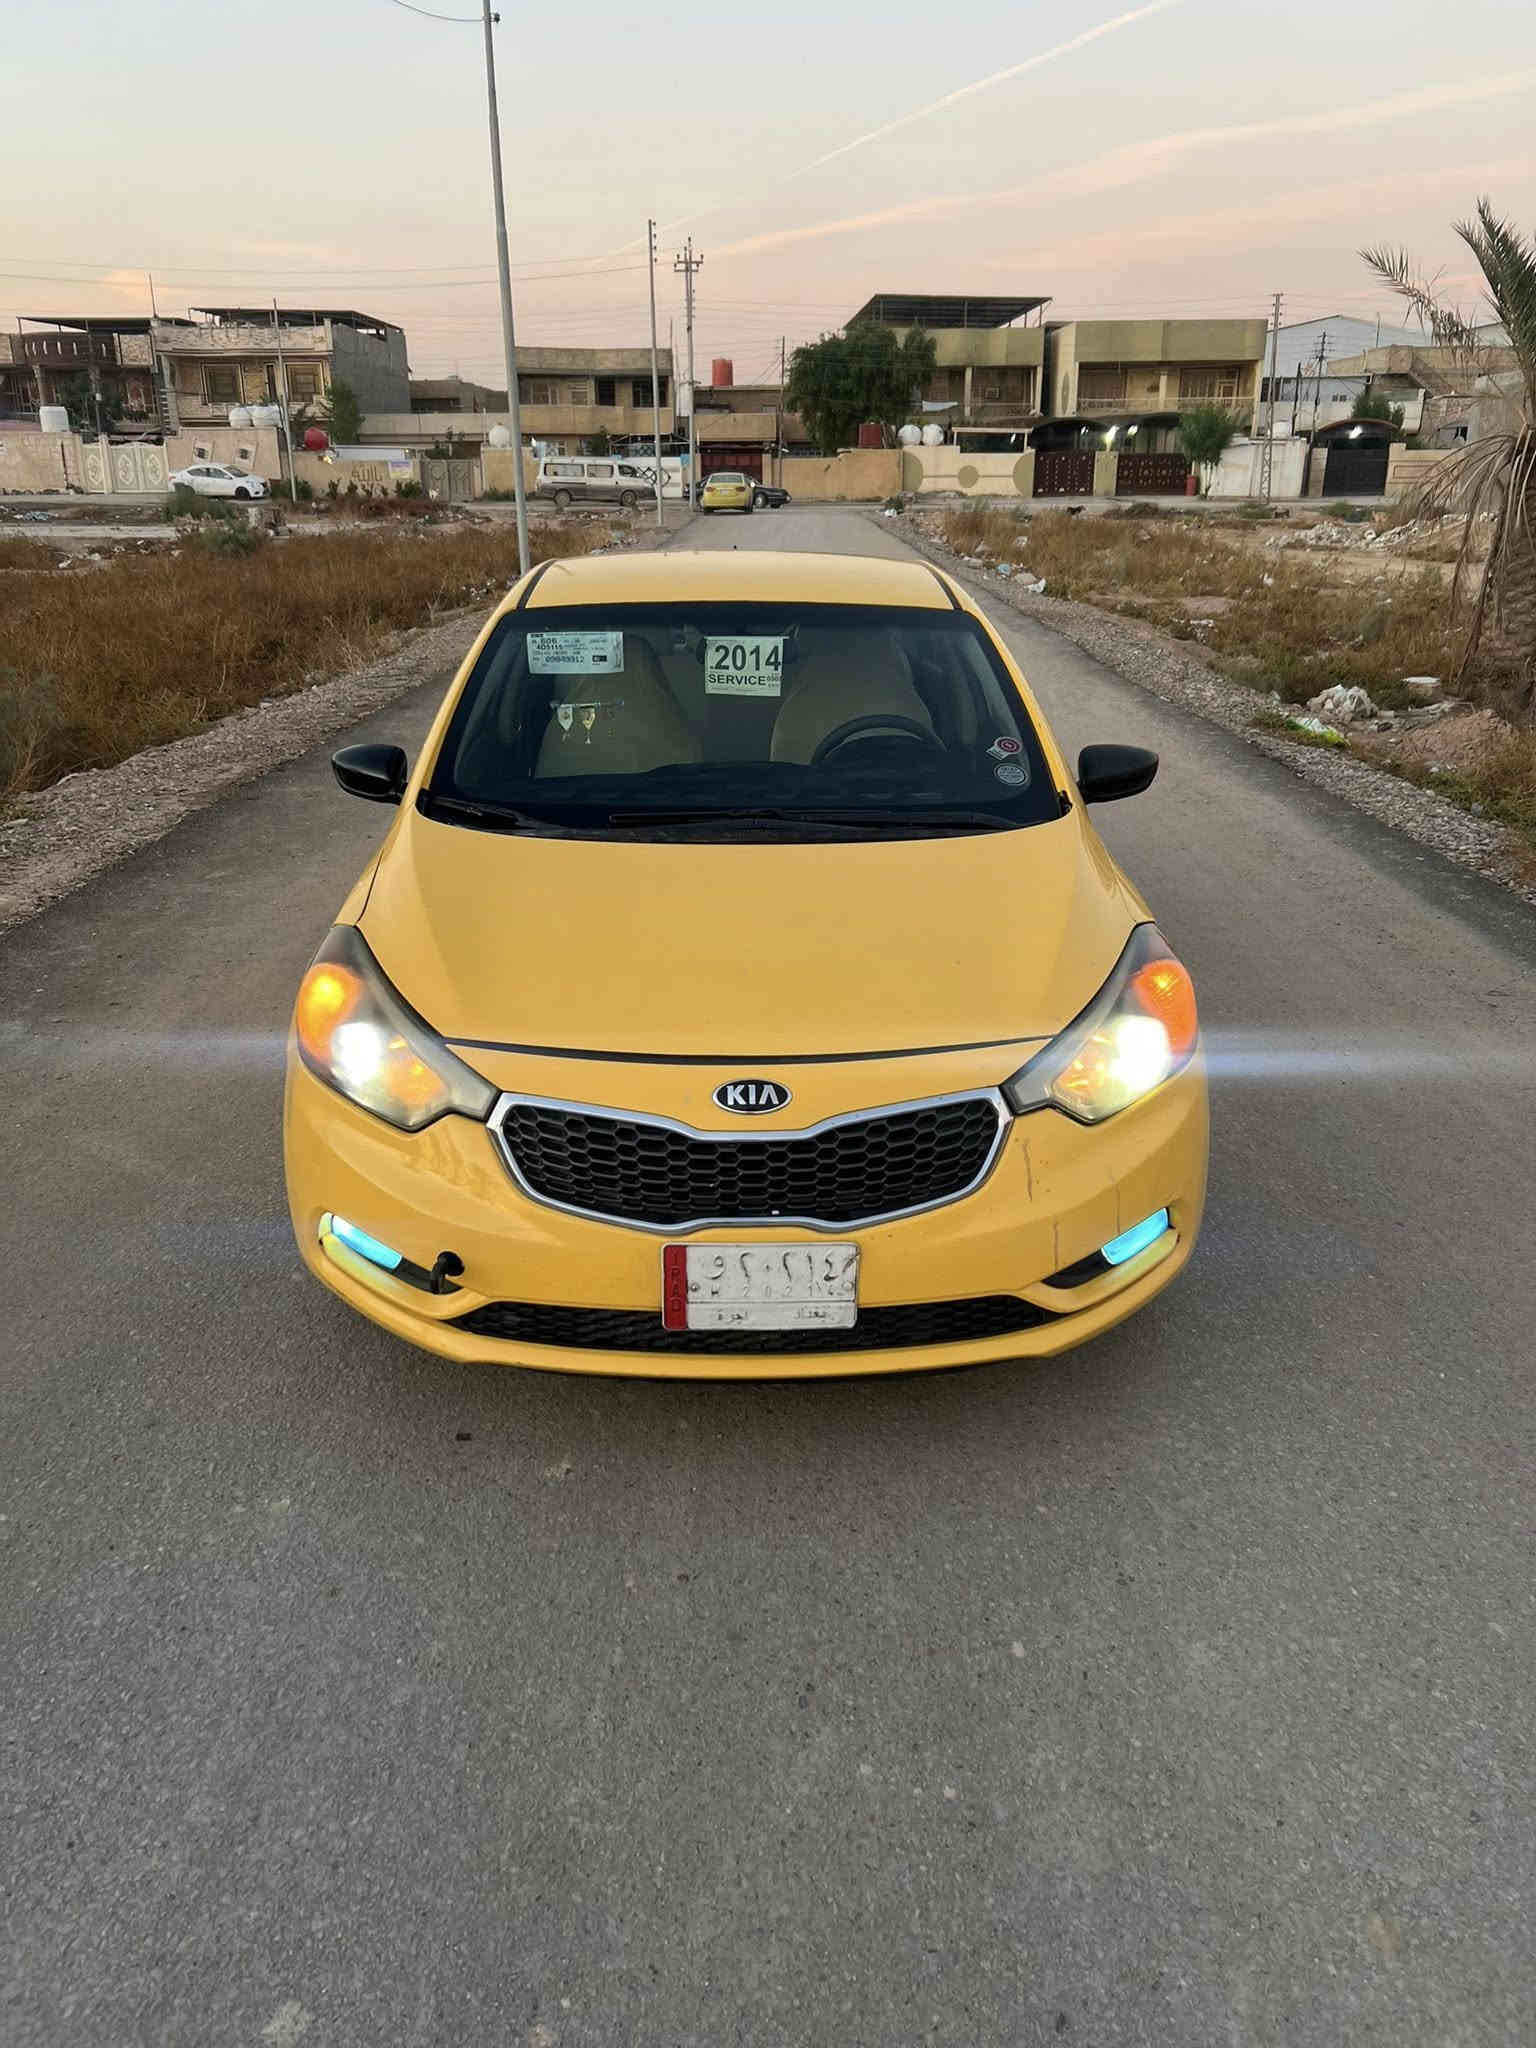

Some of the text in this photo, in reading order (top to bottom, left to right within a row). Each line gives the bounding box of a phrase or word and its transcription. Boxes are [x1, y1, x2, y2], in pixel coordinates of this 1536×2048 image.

[714, 645, 781, 672] 2014
[708, 674, 766, 686] SERVICE
[726, 1084, 780, 1106] KIA
